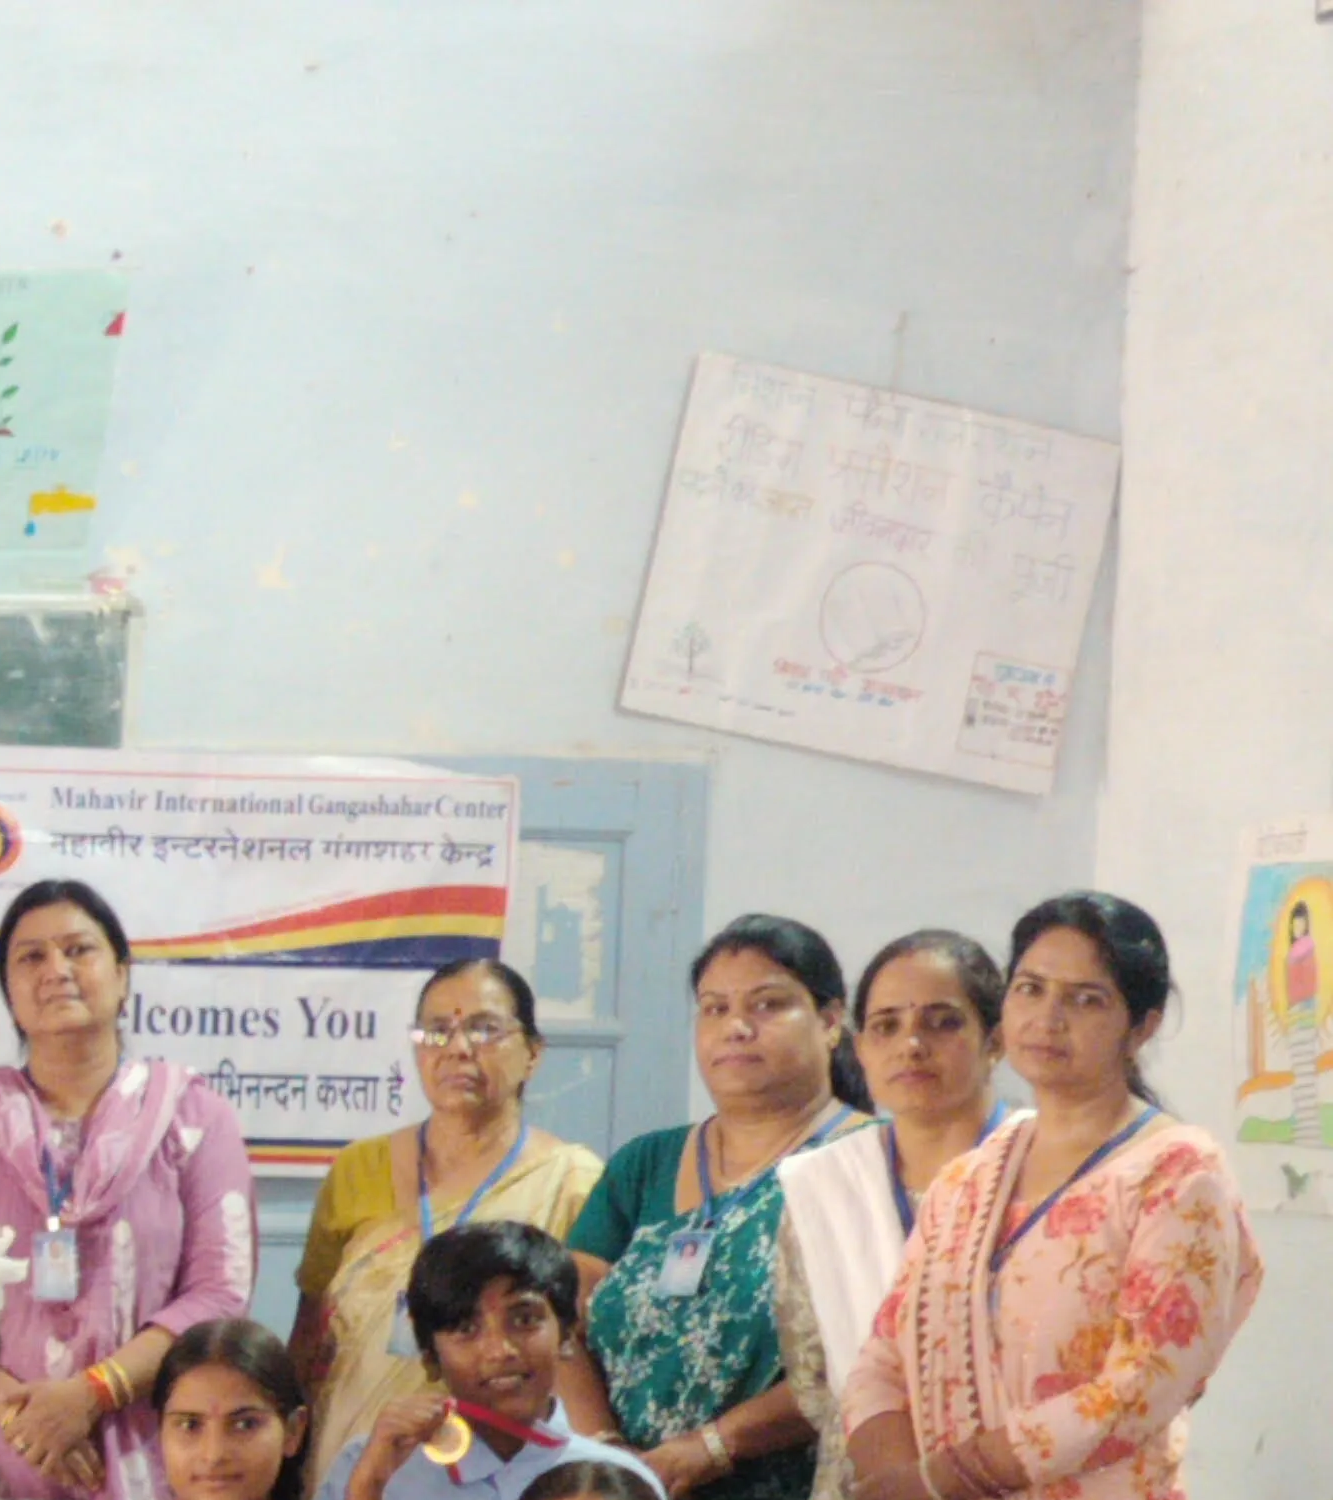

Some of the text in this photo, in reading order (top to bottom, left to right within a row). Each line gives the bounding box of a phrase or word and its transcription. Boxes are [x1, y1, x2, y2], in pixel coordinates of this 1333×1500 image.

[50, 785, 148, 813] Mahavir
[154, 789, 303, 816] International
[308, 793, 432, 823] Gangashahar
[435, 793, 508, 821] Center
[149, 827, 315, 863] इन्टरनेशनल
[320, 832, 434, 863] गंगाशहर
[439, 831, 496, 869] केन्द्र
[117, 992, 376, 1041] lcomes You
[316, 1074, 381, 1113] करता
[386, 1058, 406, 1118] है
